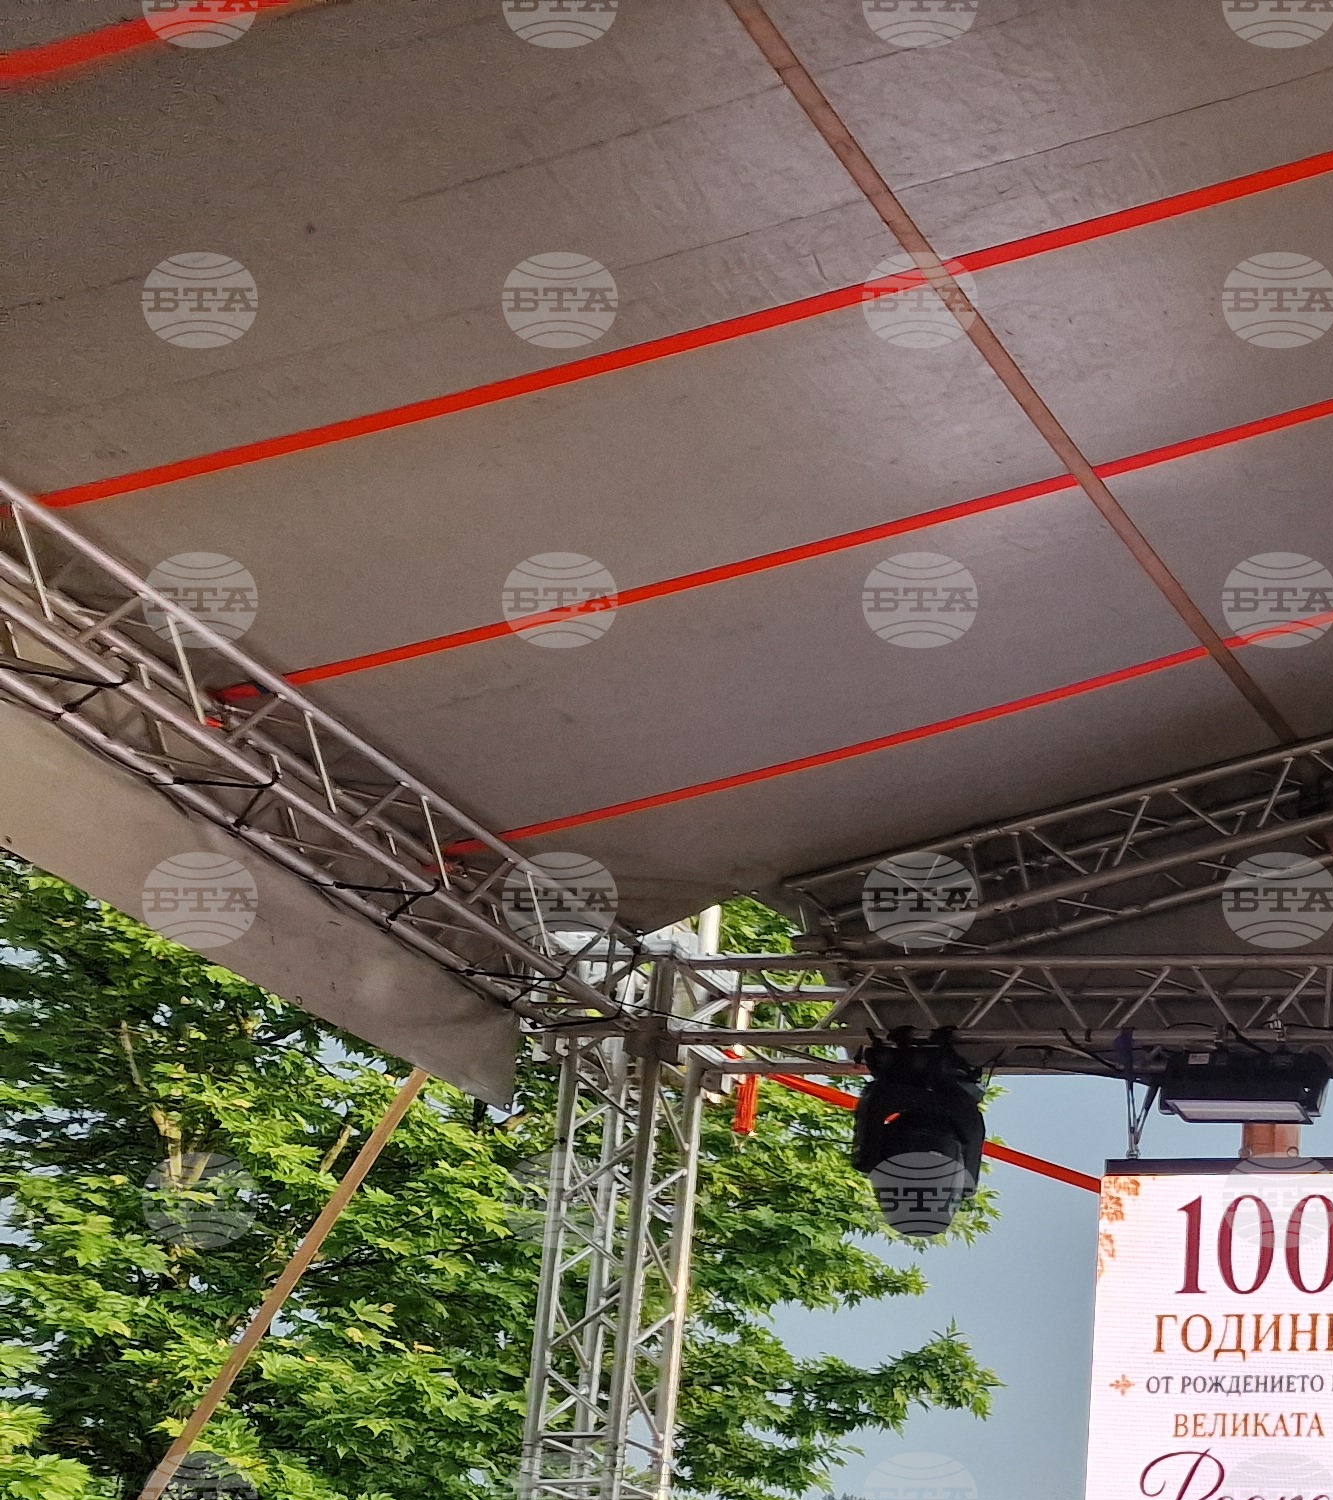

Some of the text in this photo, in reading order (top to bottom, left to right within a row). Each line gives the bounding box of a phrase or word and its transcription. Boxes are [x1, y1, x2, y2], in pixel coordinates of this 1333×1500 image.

[1146, 1375, 1171, 1394] ОТ
[1180, 1374, 1324, 1397] РОЖДЕНИЕТО
[1173, 1412, 1325, 1439] ВЕЛИКАТА
